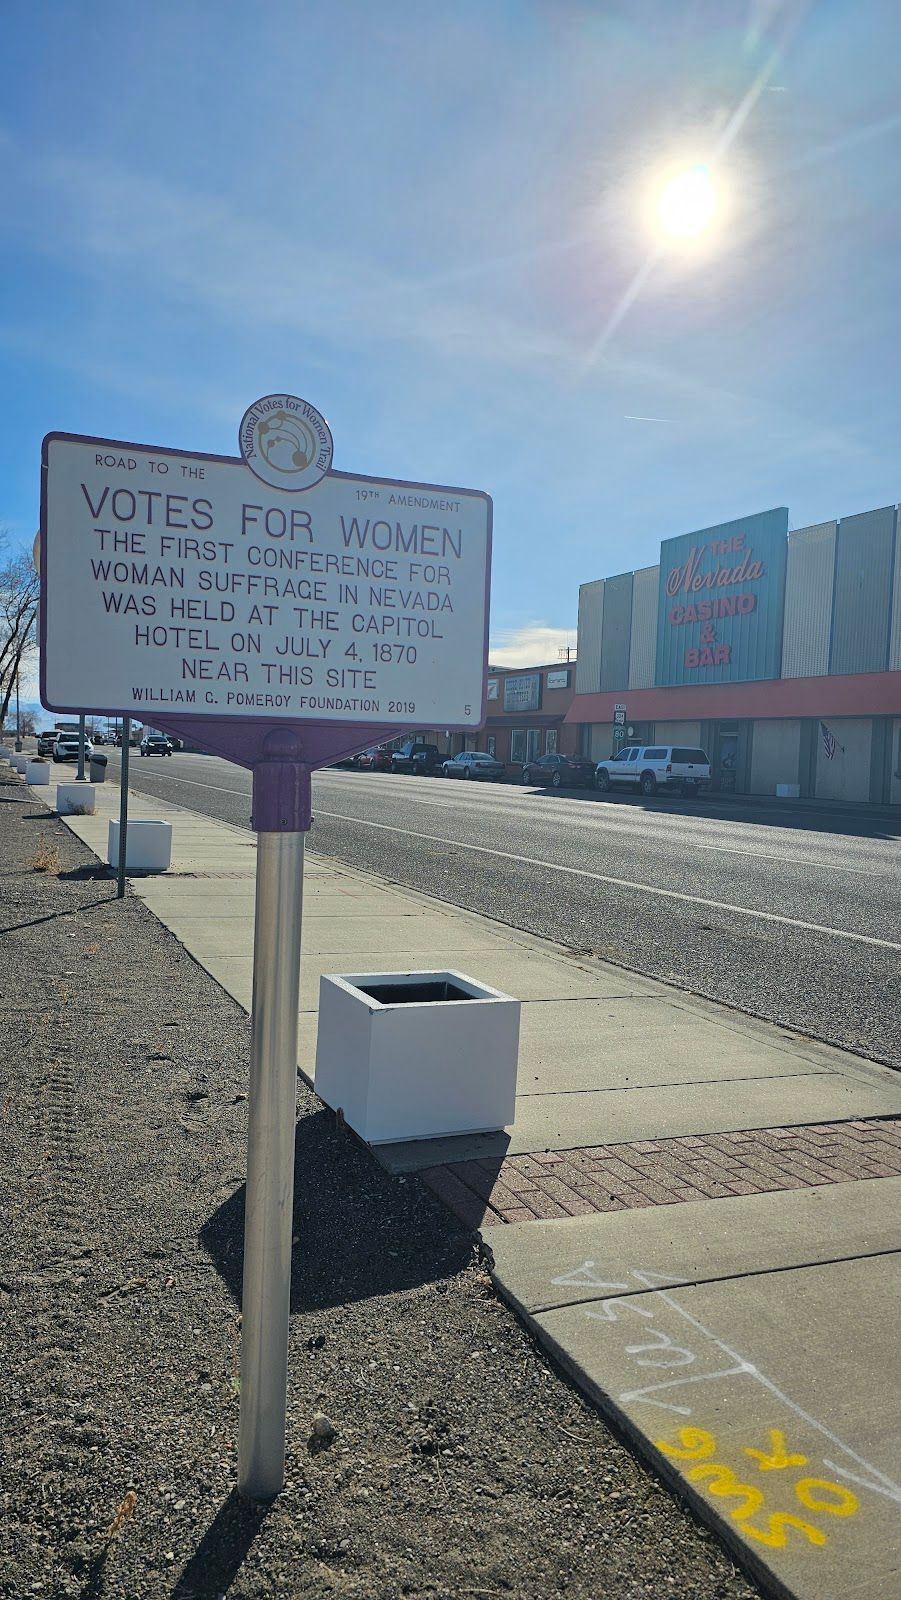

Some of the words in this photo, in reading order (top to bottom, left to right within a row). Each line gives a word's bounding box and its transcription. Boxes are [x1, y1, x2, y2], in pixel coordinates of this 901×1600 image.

[243, 410, 260, 459] National
[255, 400, 283, 415] Votes
[285, 397, 301, 411] for
[303, 405, 327, 444] Women
[316, 446, 331, 472] Trail
[95, 454, 137, 470] ROAD
[148, 461, 169, 474] TO
[180, 465, 205, 480] THE
[355, 490, 380, 501] 19TH
[388, 494, 461, 513] AMENDMENT
[80, 483, 214, 530] VOTES
[241, 503, 314, 543] FOR
[340, 515, 462, 559] WOMEN
[93, 528, 146, 555] THE
[161, 535, 234, 564] FIRST
[247, 546, 398, 580] CONFERENCE
[409, 563, 451, 586] FOR
[711, 533, 747, 557] THE
[90, 558, 184, 588] WOMAN
[198, 570, 327, 602] SUFFRAGE
[339, 583, 358, 605] IN
[370, 586, 453, 613] NEVADA
[666, 545, 764, 597] Nevada
[102, 591, 157, 616] WAS
[170, 597, 235, 622] HELD
[248, 604, 279, 626] AT
[293, 607, 339, 632] THE
[352, 613, 444, 640] CAPITOL
[669, 592, 756, 625] CASINO
[135, 624, 220, 650] HOTEL
[231, 632, 261, 653] ON
[275, 636, 332, 659] JULY
[344, 641, 363, 664] 4,
[372, 642, 417, 665] 1870
[701, 623, 716, 643] &
[685, 644, 731, 668] BAR
[181, 657, 249, 682] NEAR
[261, 663, 313, 686] THIS
[326, 668, 377, 690] SITE
[132, 687, 196, 703] WILLIAM
[205, 691, 218, 705] G.
[226, 691, 291, 708] POMEROY
[300, 695, 380, 712] FOUNDATION
[388, 700, 416, 714] 2019
[464, 704, 472, 716] 5
[615, 730, 624, 738] 80
[743, 1428, 860, 1517] OK
